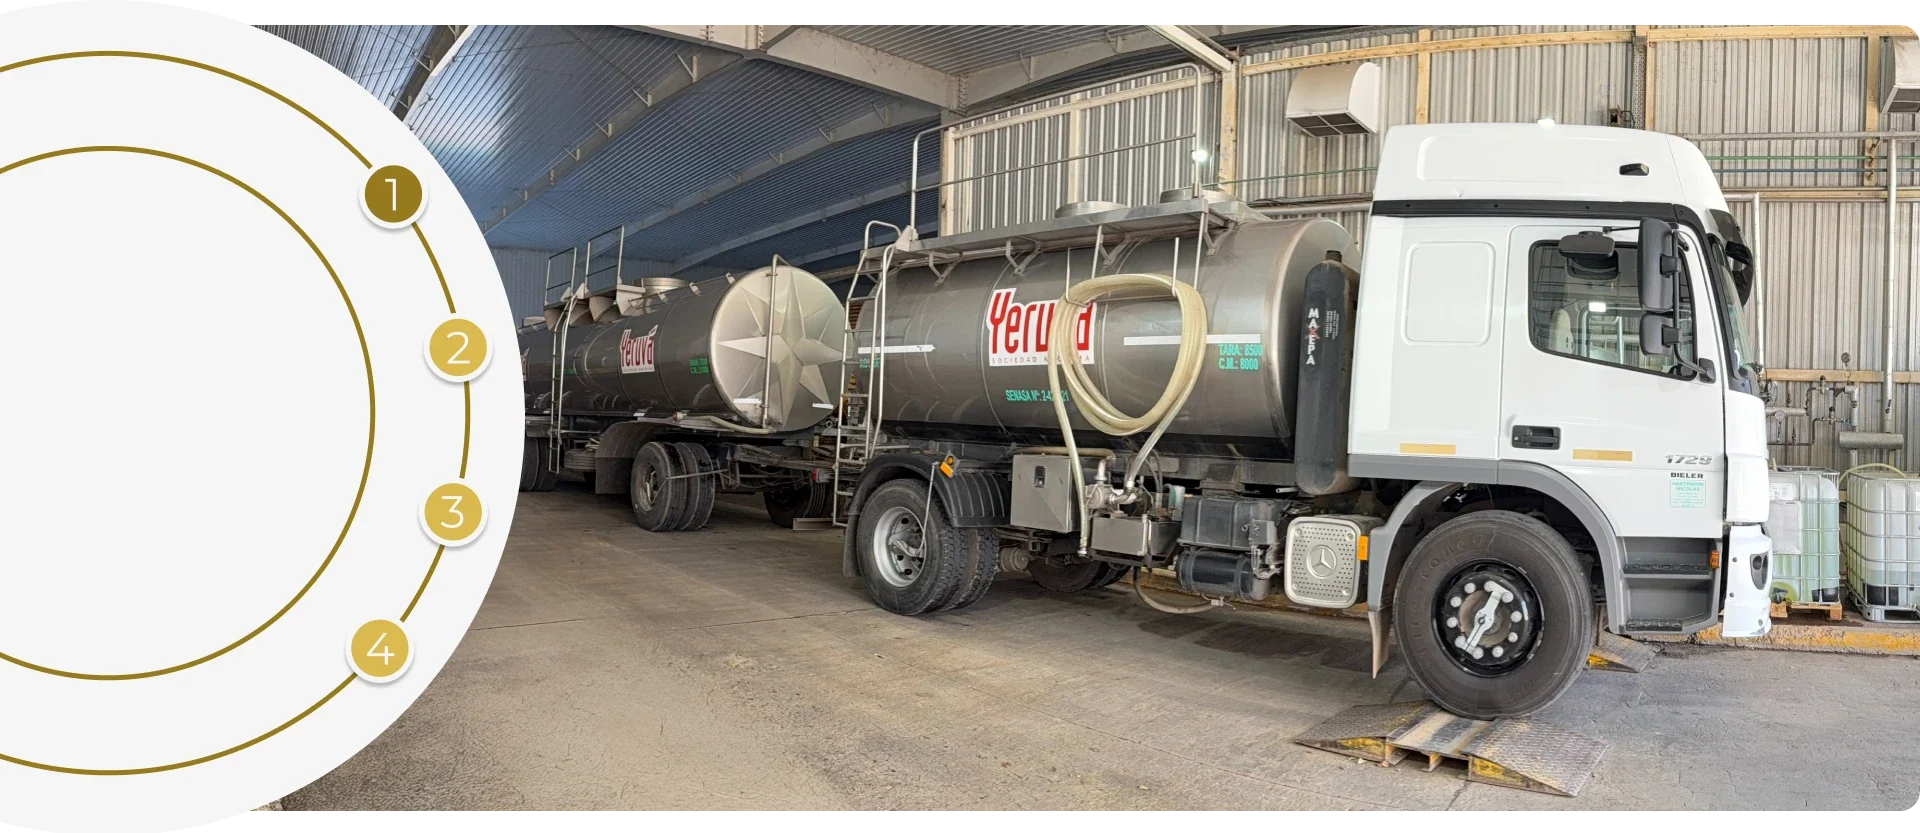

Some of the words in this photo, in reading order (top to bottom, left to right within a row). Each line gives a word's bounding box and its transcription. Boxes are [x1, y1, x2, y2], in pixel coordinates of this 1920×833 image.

[1305, 307, 1320, 366] MAXEPA
[1218, 344, 1242, 356] TARA:
[1244, 344, 1263, 357] 8500
[991, 356, 1038, 364] SOCIEDAD
[1239, 357, 1259, 370] 8000
[1005, 389, 1031, 401] SENASA
[1664, 454, 1712, 465] 1729
